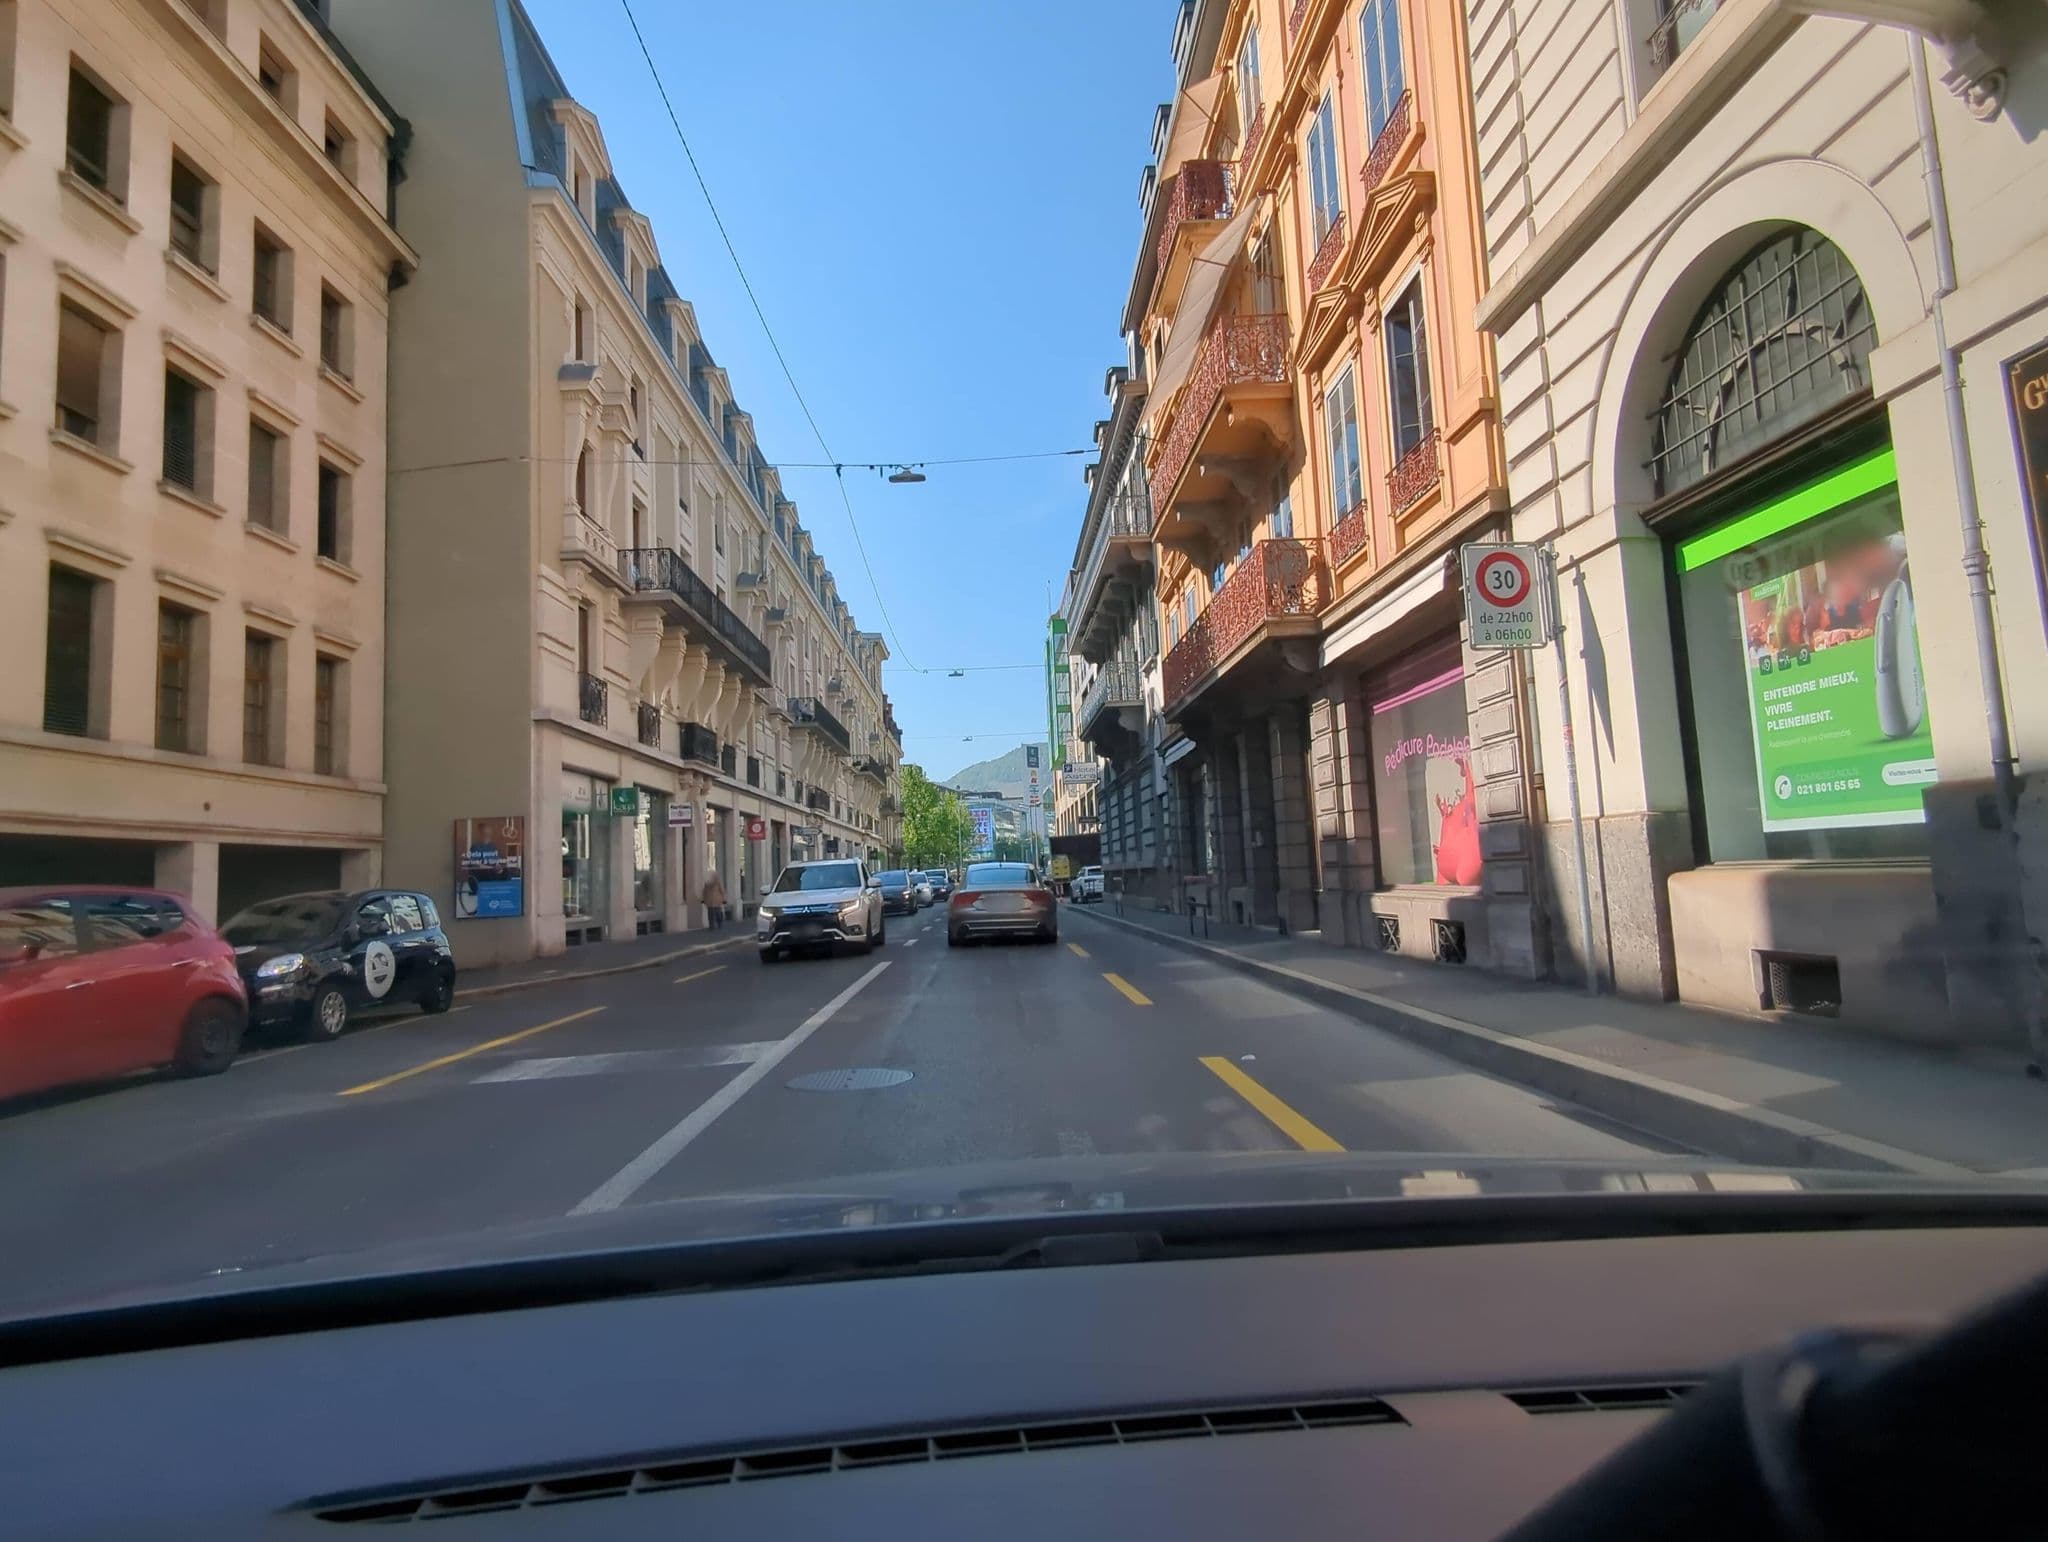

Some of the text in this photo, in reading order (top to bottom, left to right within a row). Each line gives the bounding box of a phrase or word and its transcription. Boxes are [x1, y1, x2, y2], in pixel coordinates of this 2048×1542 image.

[1492, 570, 1515, 590] 30
[1480, 612, 1533, 624] de 22h00
[1485, 628, 1532, 641] à 06h00
[1763, 671, 1859, 701] ENTENDRE MIEUX,
[1765, 702, 1793, 716] VIVRE
[1767, 710, 1834, 731] PLEINEMENT.
[1797, 778, 1861, 795] 021 801 65 65
